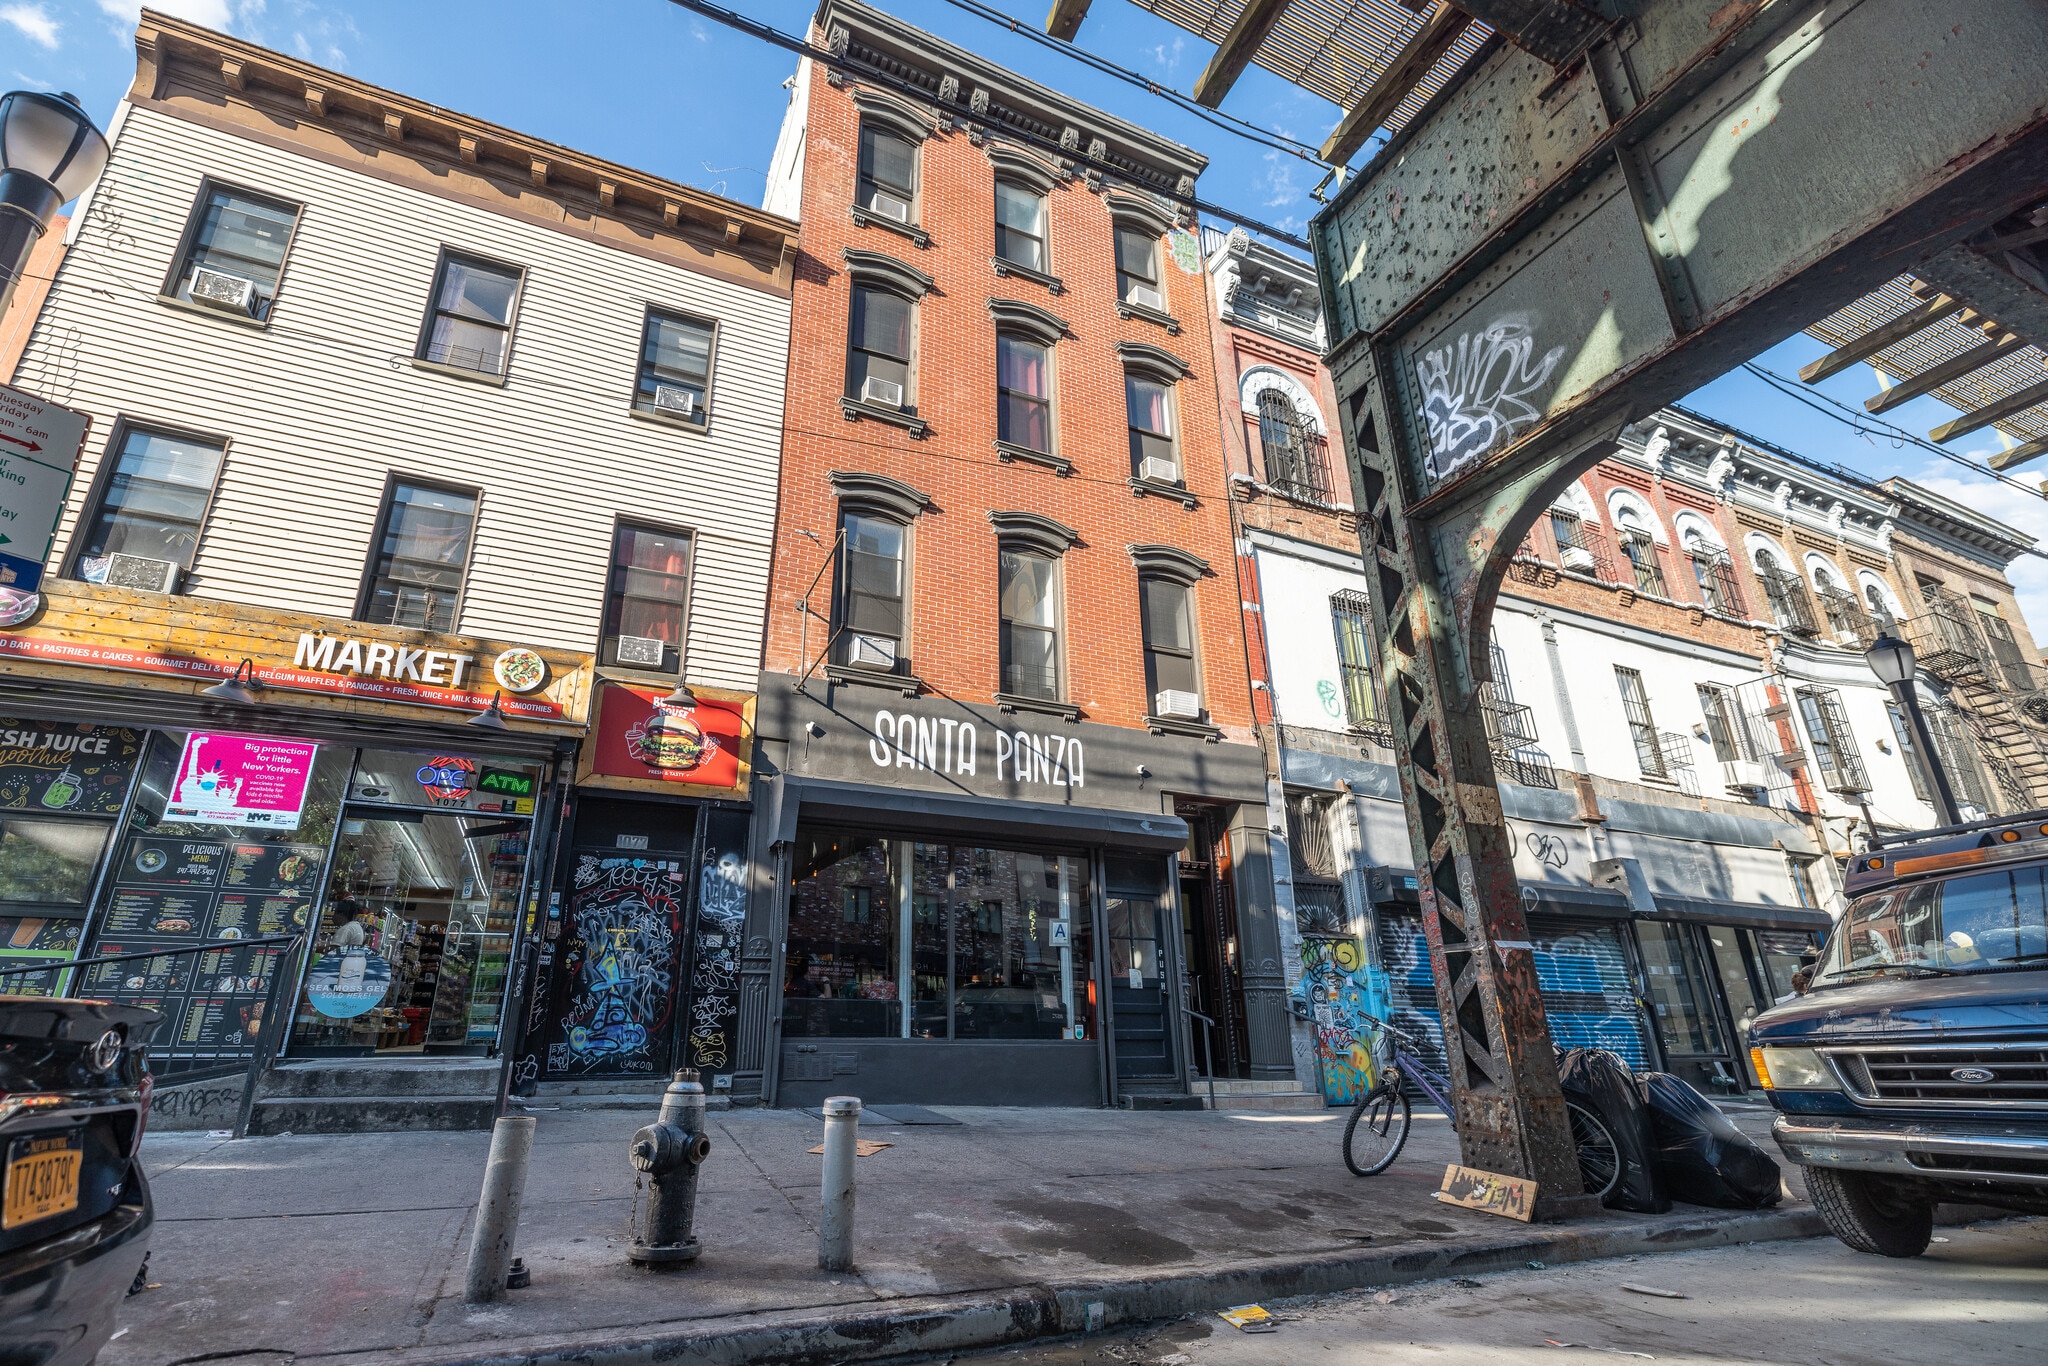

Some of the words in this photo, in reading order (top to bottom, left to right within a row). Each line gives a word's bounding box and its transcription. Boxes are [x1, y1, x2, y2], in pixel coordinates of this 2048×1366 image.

[25, 426, 49, 440] 6am
[293, 633, 473, 686] MARKET
[9, 641, 31, 650] BAR
[42, 644, 90, 657] PASTRIES
[91, 650, 100, 659] &
[101, 651, 134, 663] CAKES
[144, 656, 190, 670] GOURMET
[191, 661, 212, 673] DELI
[213, 665, 221, 673] &
[258, 670, 295, 681] BELGUM
[297, 674, 336, 687] WAFFLES
[337, 679, 345, 688] &
[346, 681, 384, 692] PANCAKE
[392, 687, 419, 697] FRESH
[419, 690, 443, 700] JUICE
[450, 694, 471, 704] MILK
[472, 698, 502, 708] SHAKS
[510, 701, 552, 714] SMOOTHIES
[658, 707, 690, 720] HOUSE
[40, 733, 111, 755] JUICE
[244, 743, 260, 753] Big
[261, 746, 309, 756] protection
[869, 710, 976, 777] SANTA
[996, 729, 1084, 788] PANZA
[256, 753, 270, 762] for
[271, 755, 292, 764] little
[242, 762, 264, 771] New
[266, 764, 301, 775] Yorkers.
[482, 773, 530, 793] ATM
[436, 798, 466, 808] 1077
[246, 812, 271, 821] NYC
[618, 835, 648, 849] 1077
[182, 844, 222, 856] DELICIOUS
[1054, 924, 1066, 938] A
[1158, 949, 1167, 990] PUSH
[309, 984, 329, 992] SEA
[333, 985, 363, 993] MOSS
[366, 985, 386, 993] GEL
[346, 992, 372, 1000] HERE!
[1960, 1070, 1983, 1079] Ford
[14, 1155, 74, 1209] T743879C
